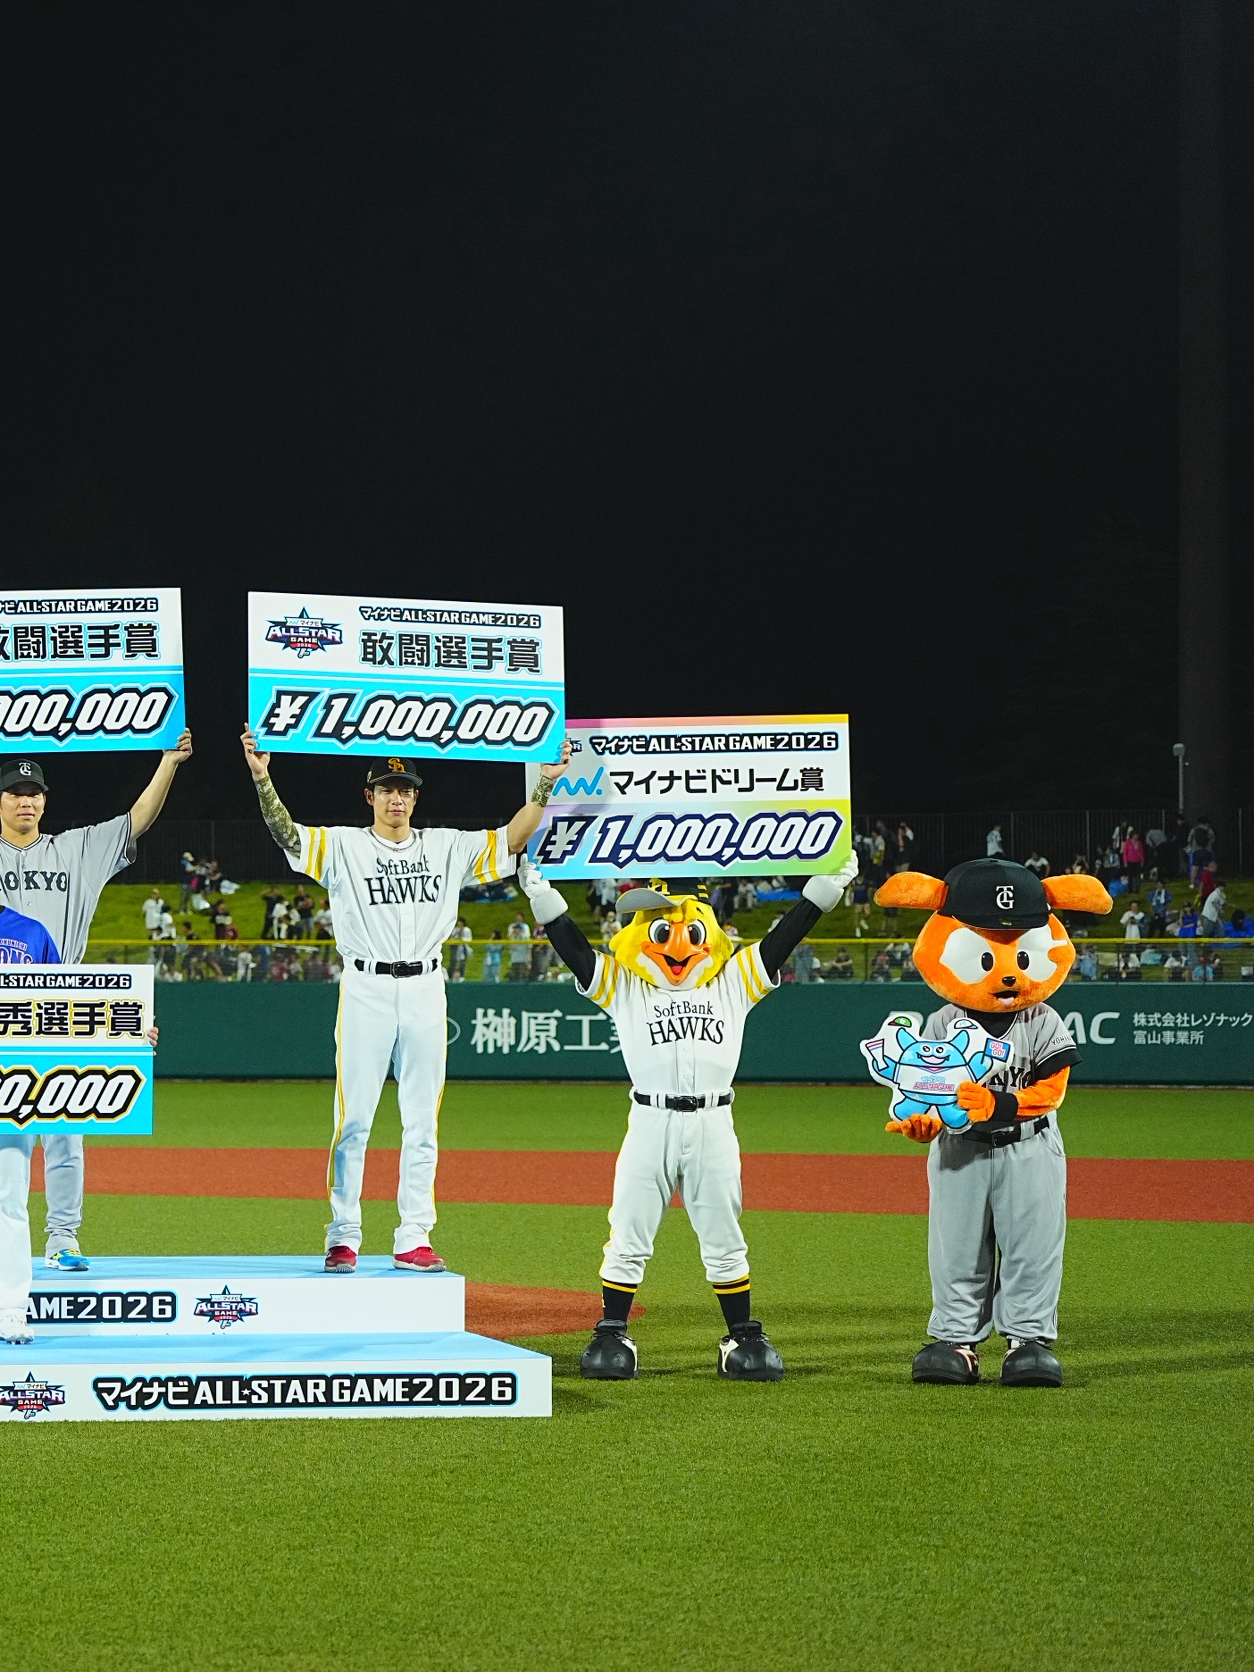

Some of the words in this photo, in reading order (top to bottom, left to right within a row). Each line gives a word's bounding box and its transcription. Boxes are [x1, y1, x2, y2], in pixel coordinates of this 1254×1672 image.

[361, 631, 541, 673] 敢闘選手賞
[609, 767, 825, 795] マイナビドリーム賞
[376, 854, 430, 876] SoftBank
[363, 874, 442, 906] HAWKS
[654, 1001, 714, 1018] SoftBank
[1133, 1012, 1253, 1027] 株式会社レゾナック
[647, 1016, 724, 1046] HAWKS
[1133, 1030, 1204, 1045] 富山事業所
